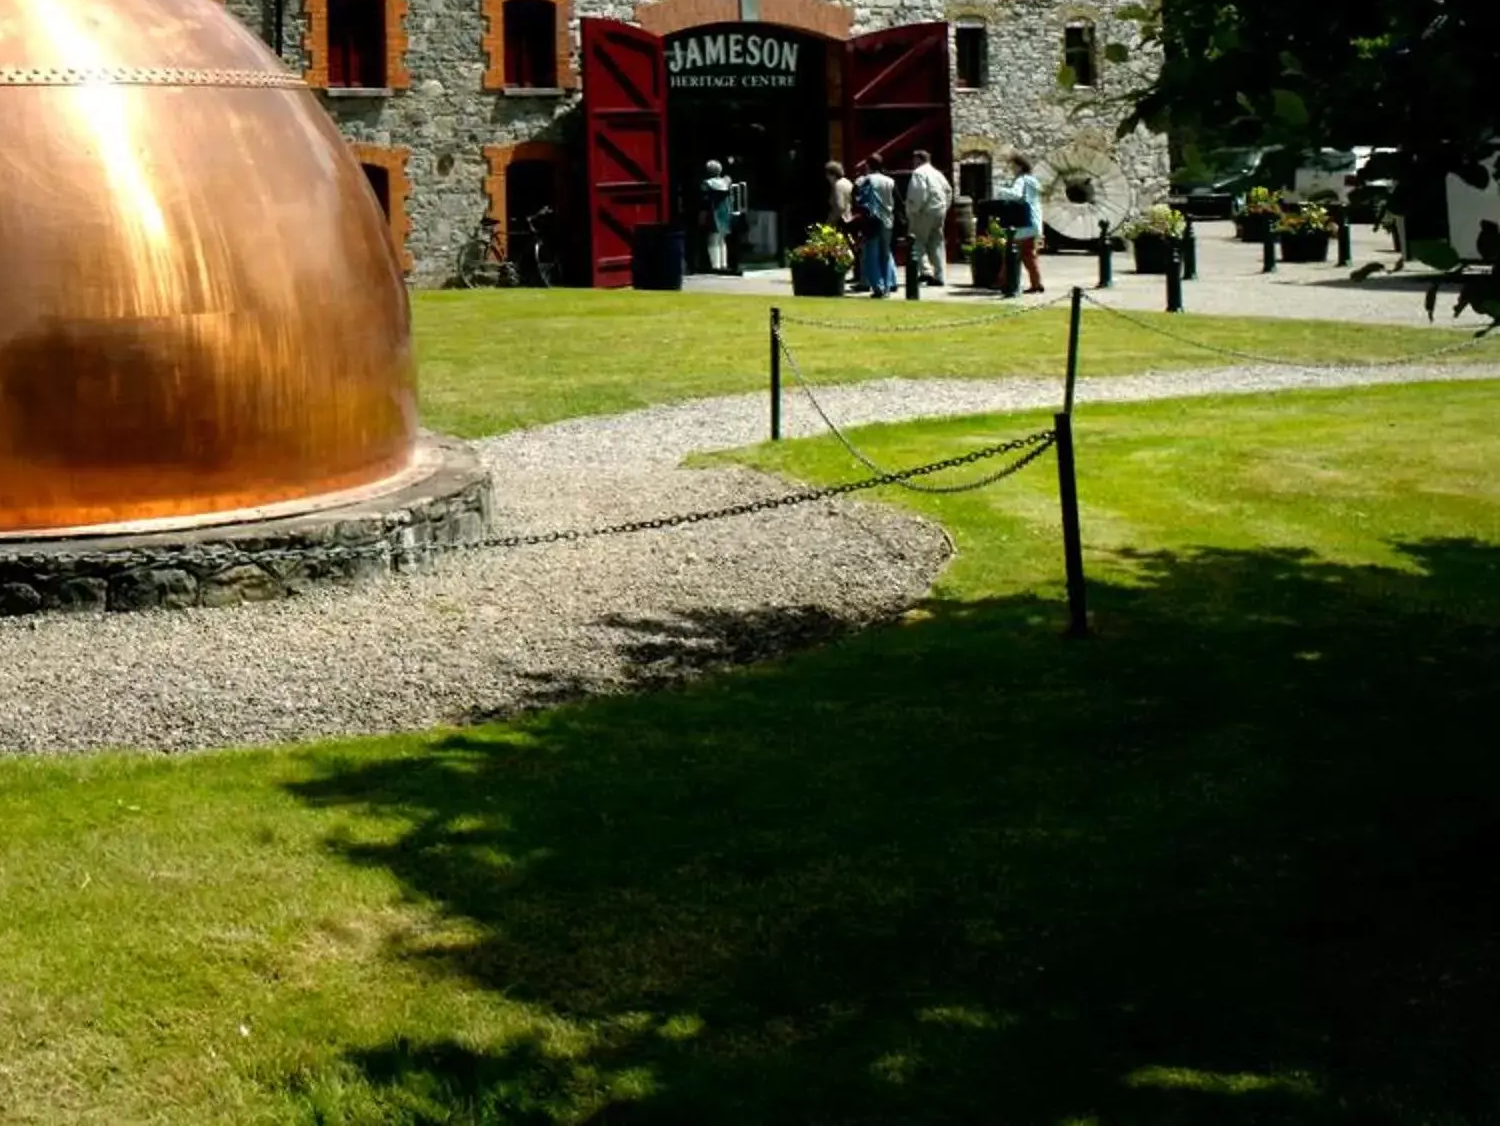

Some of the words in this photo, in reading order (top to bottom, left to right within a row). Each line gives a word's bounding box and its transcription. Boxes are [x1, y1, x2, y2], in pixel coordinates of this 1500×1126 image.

[669, 33, 799, 72] JAMESON
[670, 75, 737, 88] HERITAGE
[741, 75, 796, 88] CENTRE
